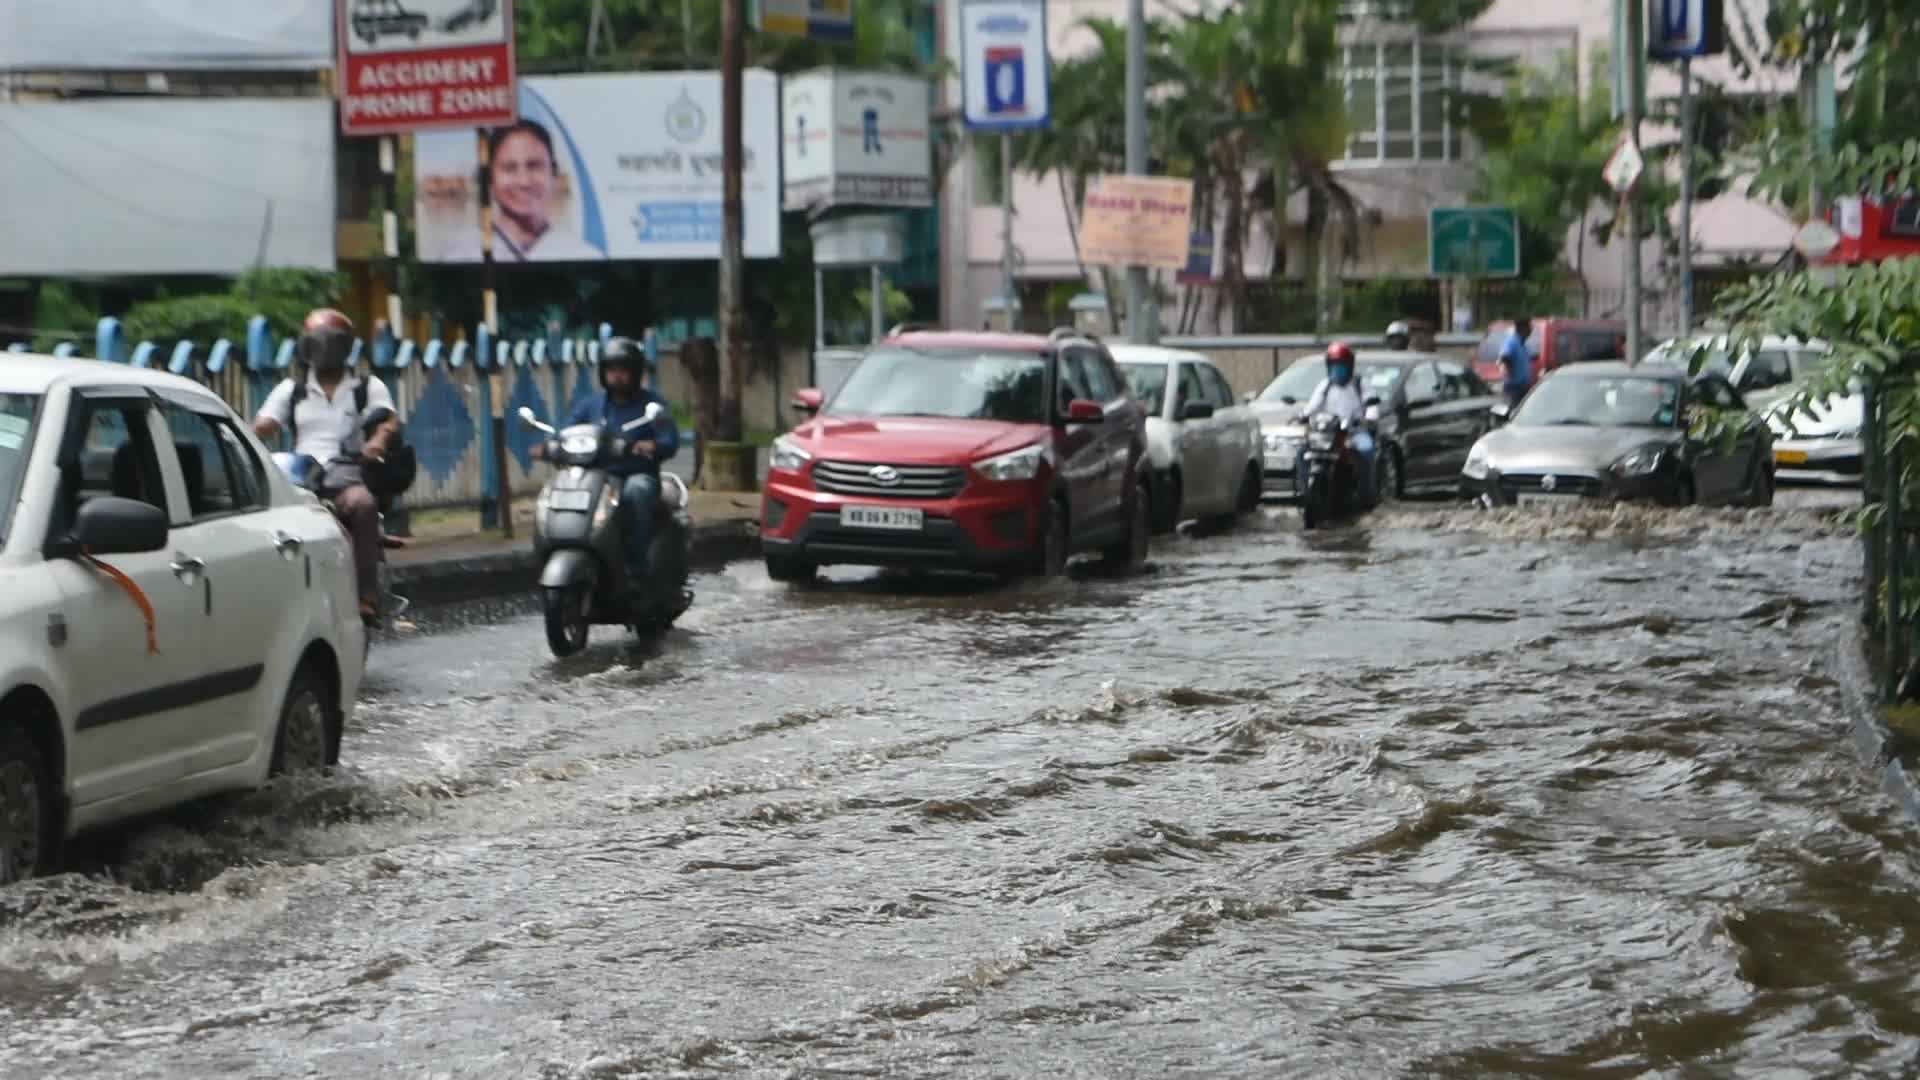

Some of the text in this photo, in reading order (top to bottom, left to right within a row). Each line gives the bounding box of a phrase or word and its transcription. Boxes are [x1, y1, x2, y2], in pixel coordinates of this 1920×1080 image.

[358, 57, 495, 88] ACCIDENT
[346, 86, 509, 118] PRONE ZONE
